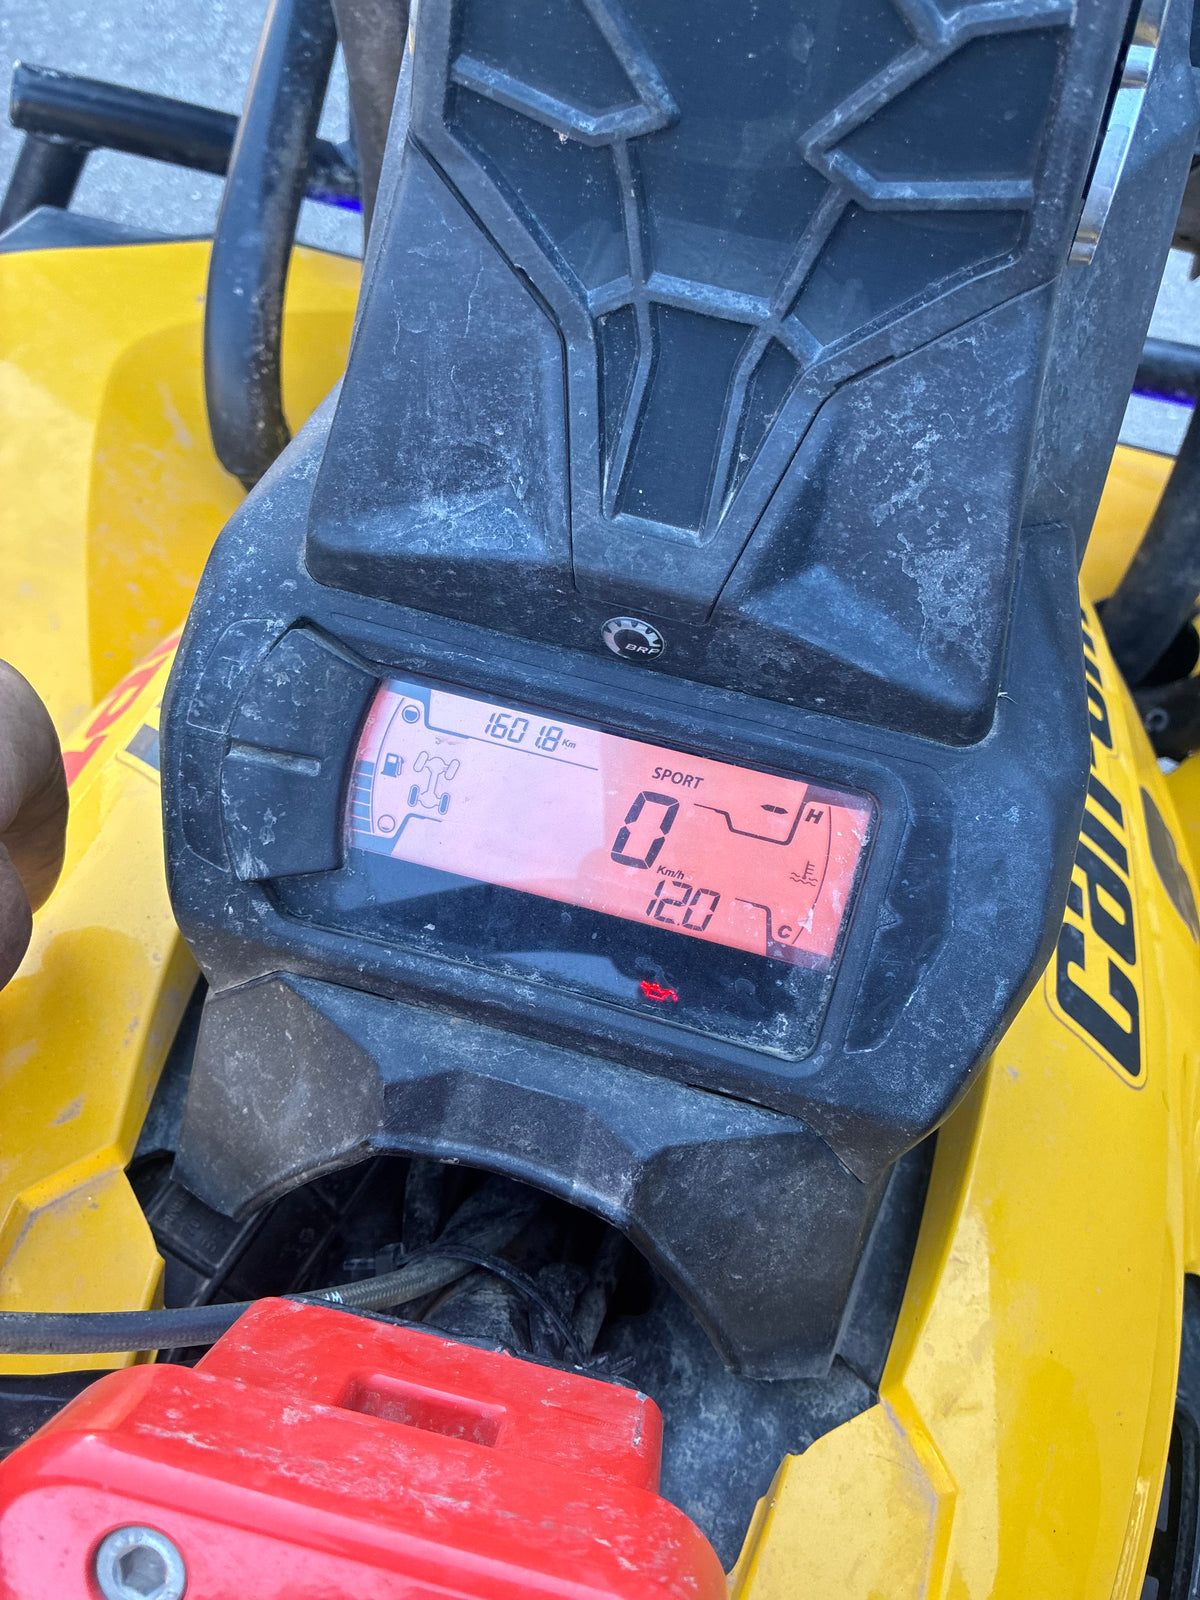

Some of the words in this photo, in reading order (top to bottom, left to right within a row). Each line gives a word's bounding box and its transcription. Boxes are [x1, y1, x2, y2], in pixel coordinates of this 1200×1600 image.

[625, 643, 660, 655] BRP
[561, 738, 577, 750] Km
[652, 767, 704, 790] SPORT
[805, 808, 824, 825] H
[611, 791, 680, 870] 0
[656, 865, 685, 880] Km/h
[777, 924, 793, 939] C
